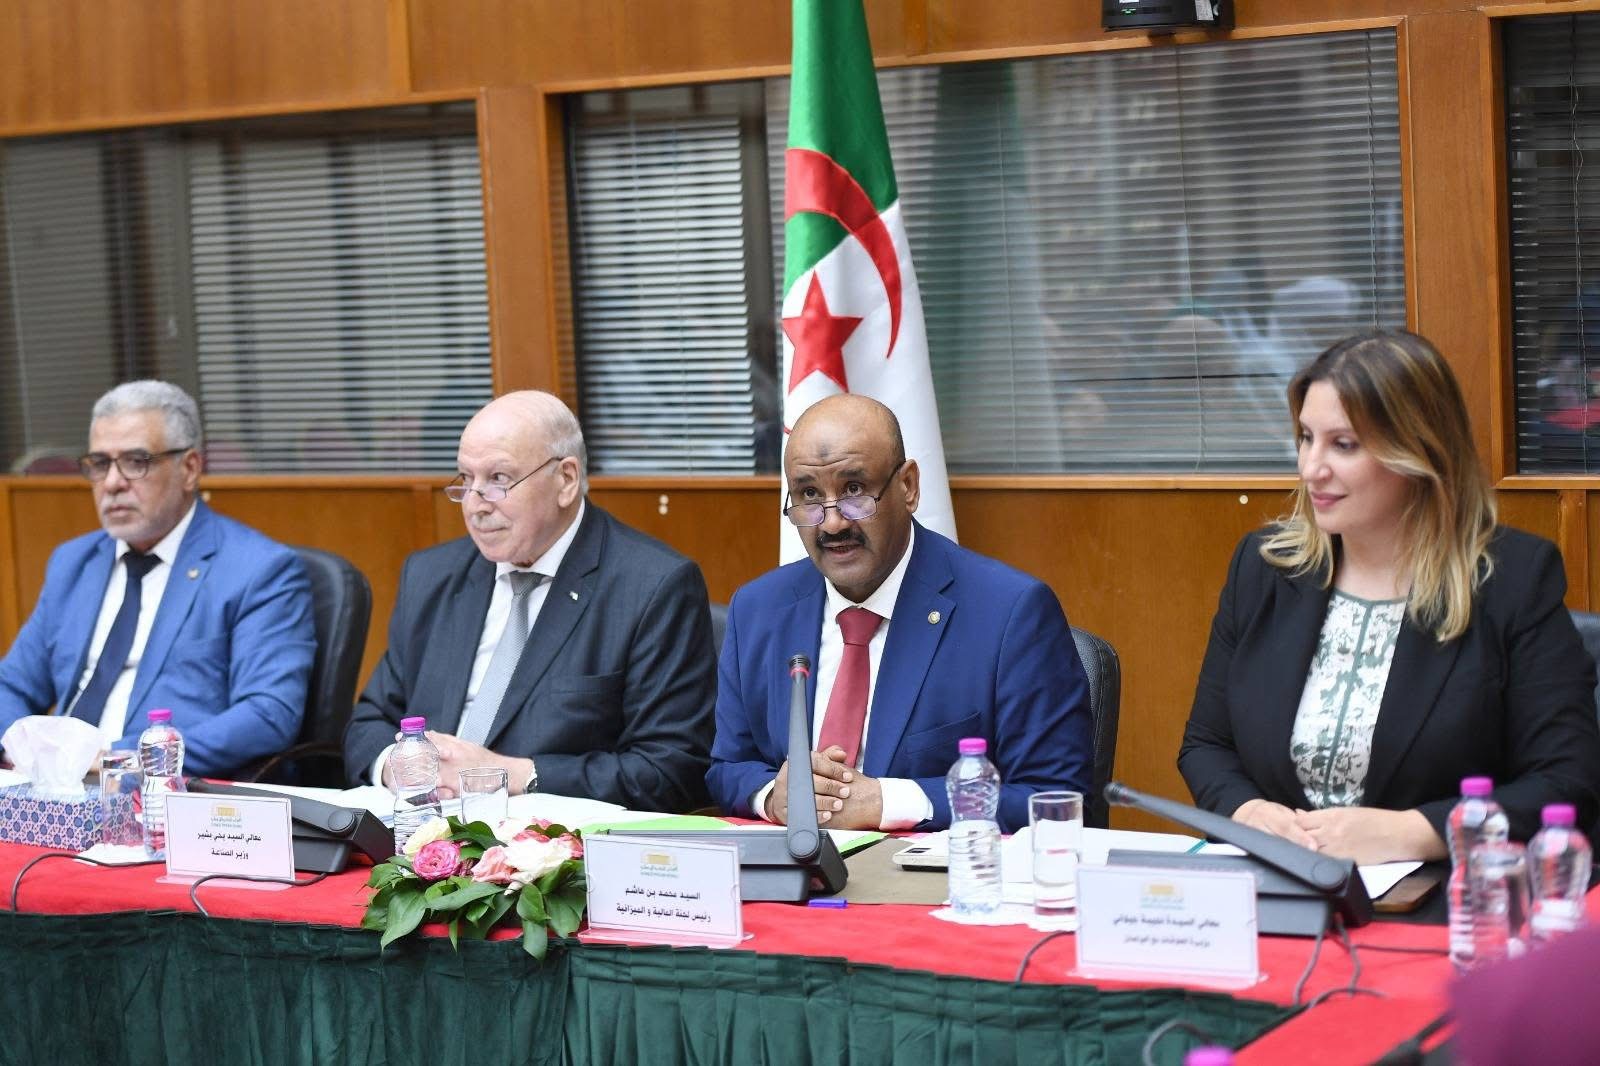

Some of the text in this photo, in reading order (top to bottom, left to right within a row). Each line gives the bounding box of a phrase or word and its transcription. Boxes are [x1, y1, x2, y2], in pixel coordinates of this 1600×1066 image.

[227, 833, 244, 842] السيد
[646, 889, 655, 899] بن
[658, 890, 677, 898] محمد
[680, 892, 700, 901] السيد
